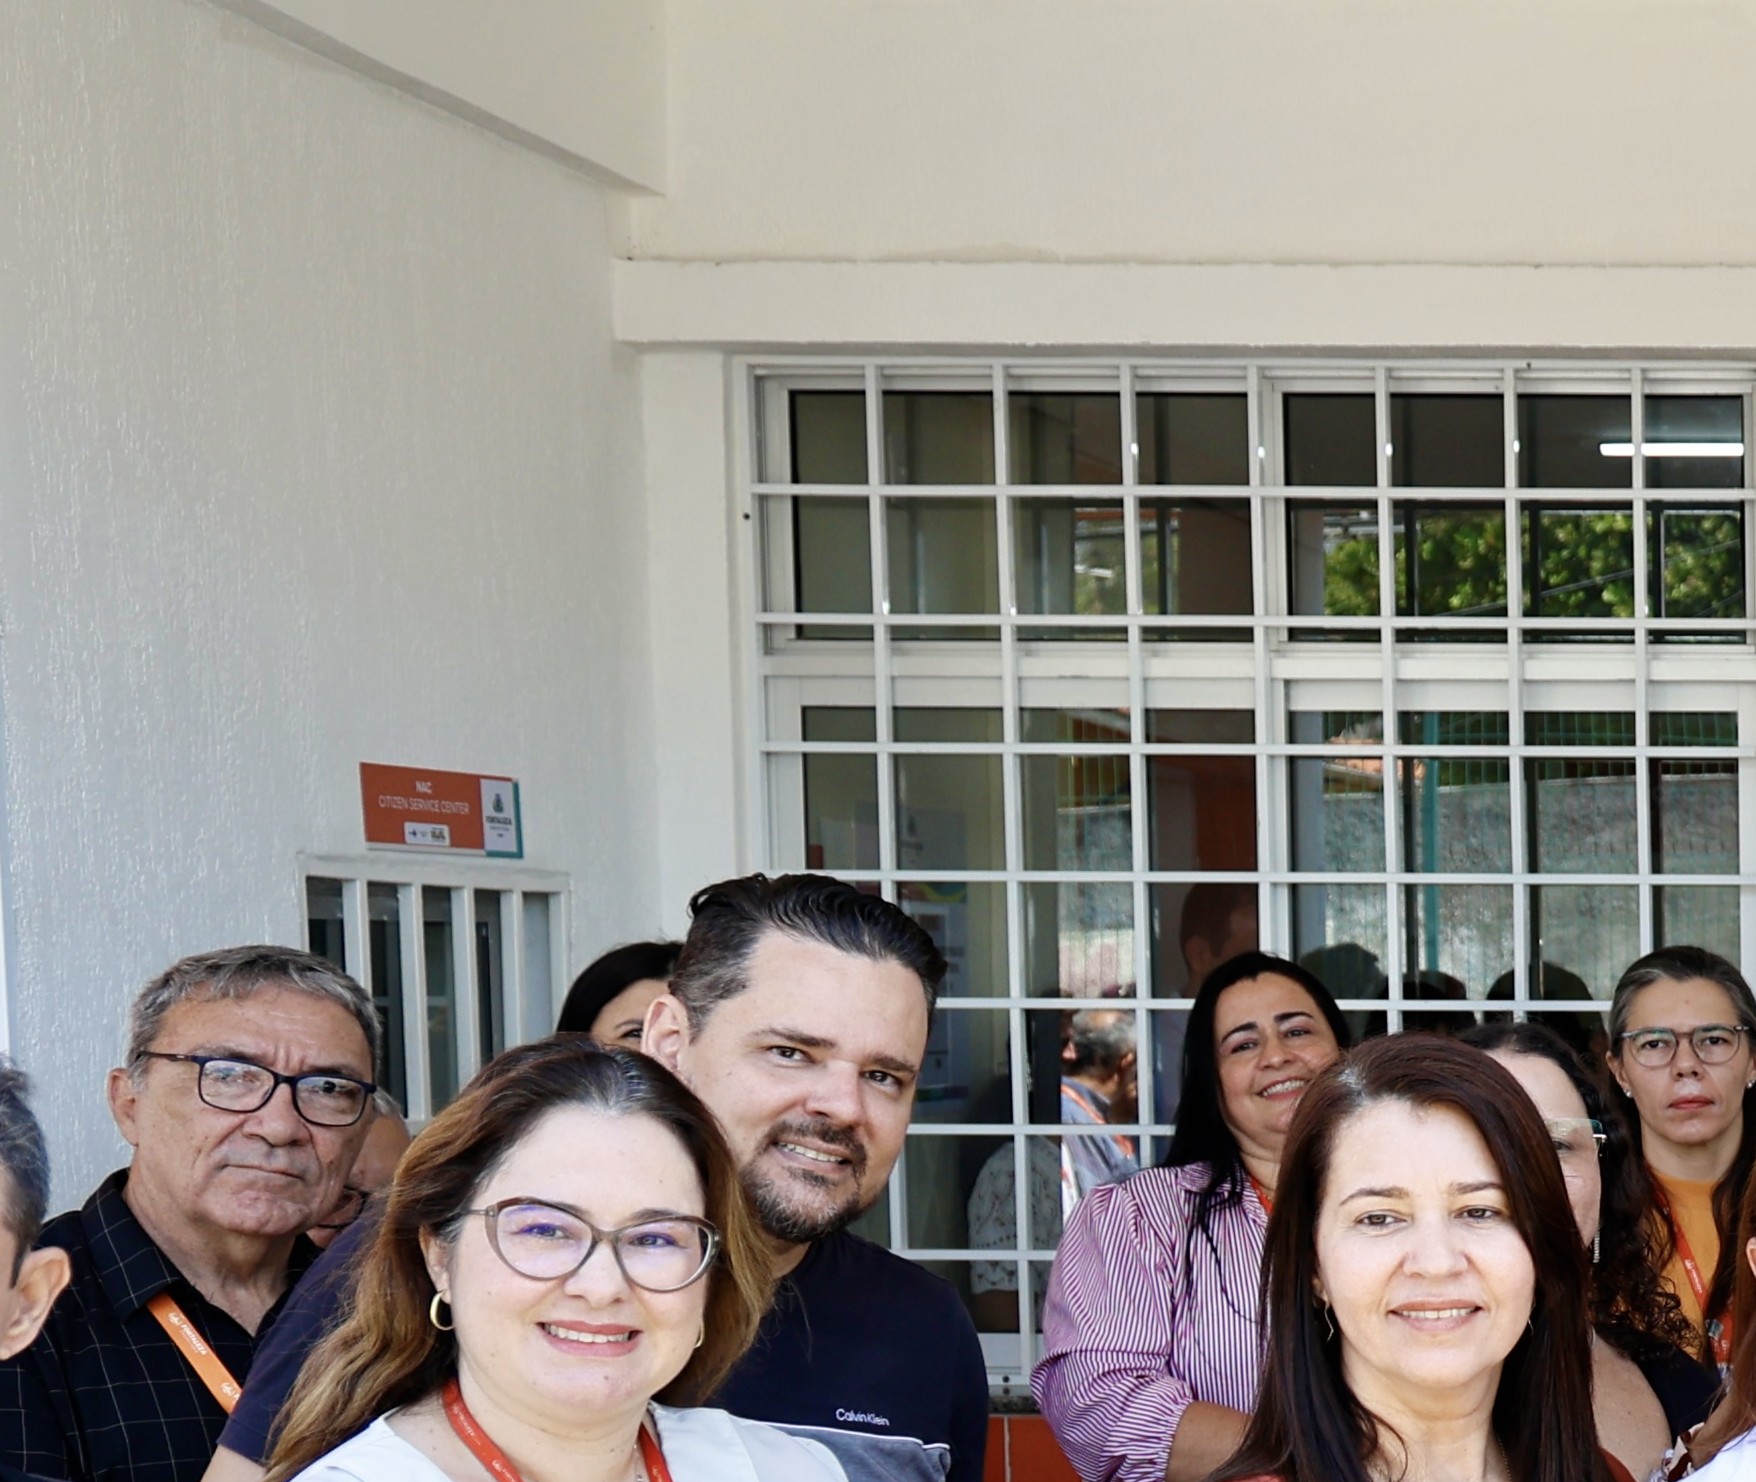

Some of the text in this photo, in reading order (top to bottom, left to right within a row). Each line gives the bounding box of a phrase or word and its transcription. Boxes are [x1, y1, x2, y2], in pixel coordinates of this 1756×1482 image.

[415, 781, 432, 793] NAC
[410, 798, 440, 813] SERVICE
[836, 1408, 867, 1423] Calvin
